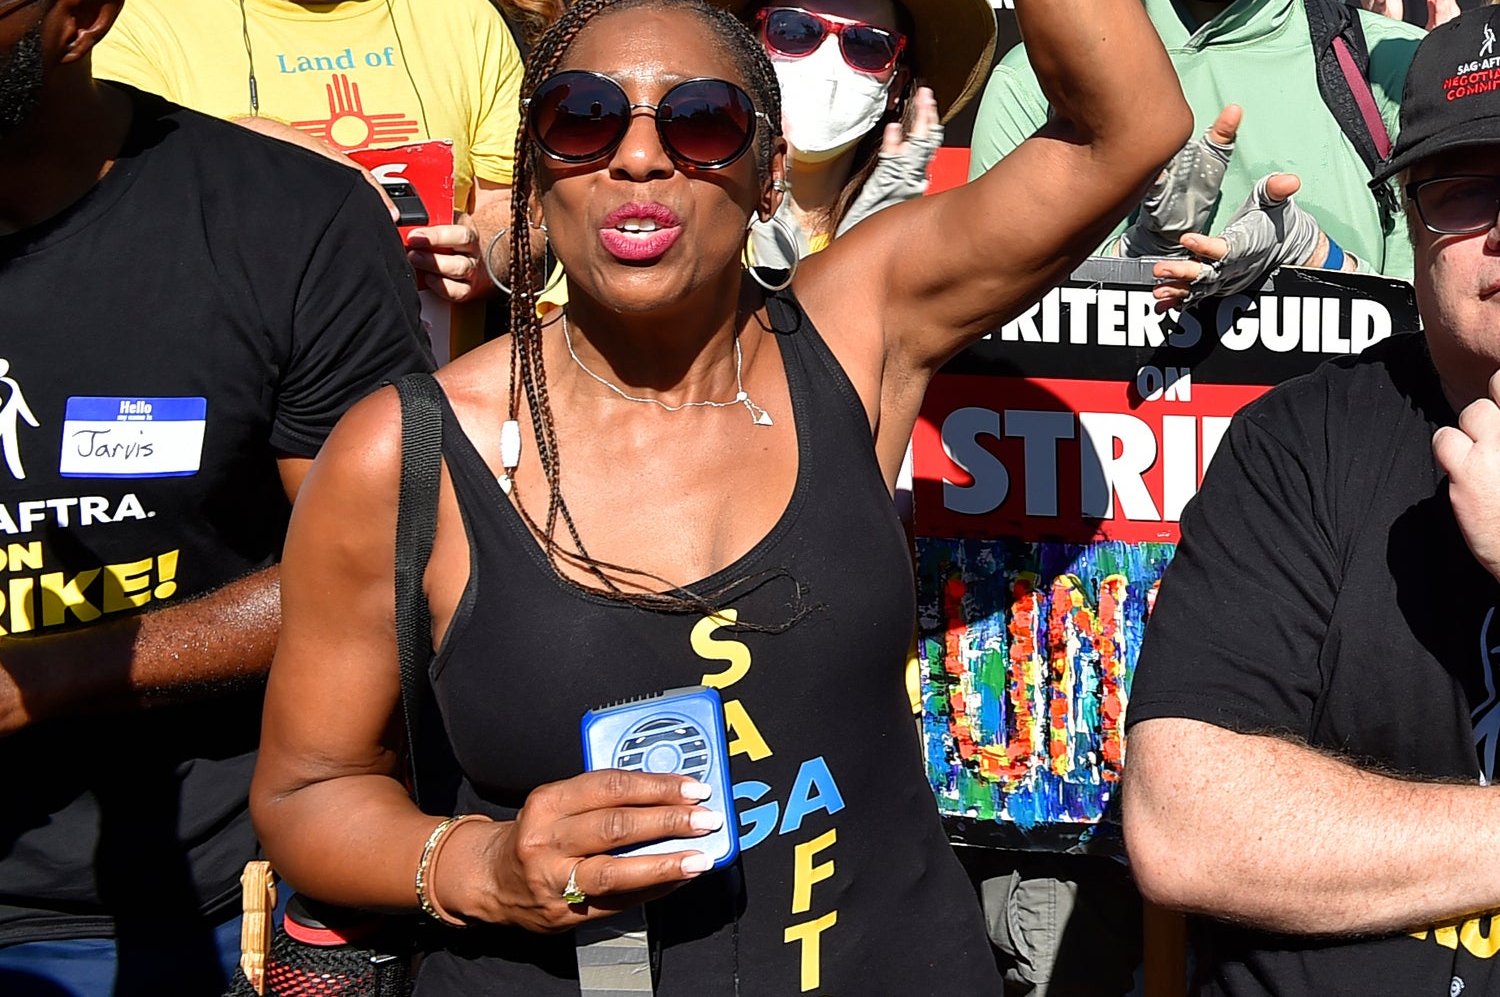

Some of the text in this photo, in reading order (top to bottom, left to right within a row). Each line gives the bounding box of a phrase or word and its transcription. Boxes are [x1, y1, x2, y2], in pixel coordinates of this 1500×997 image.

[276, 47, 395, 74] Land of
[1000, 286, 1392, 354] RITERS GUILD
[1136, 366, 1192, 402] ON
[120, 401, 152, 414] Hello
[72, 428, 154, 460] Jarvis
[941, 407, 1233, 522] STRI
[0, 541, 43, 572] N
[0, 549, 179, 636] IKE!
